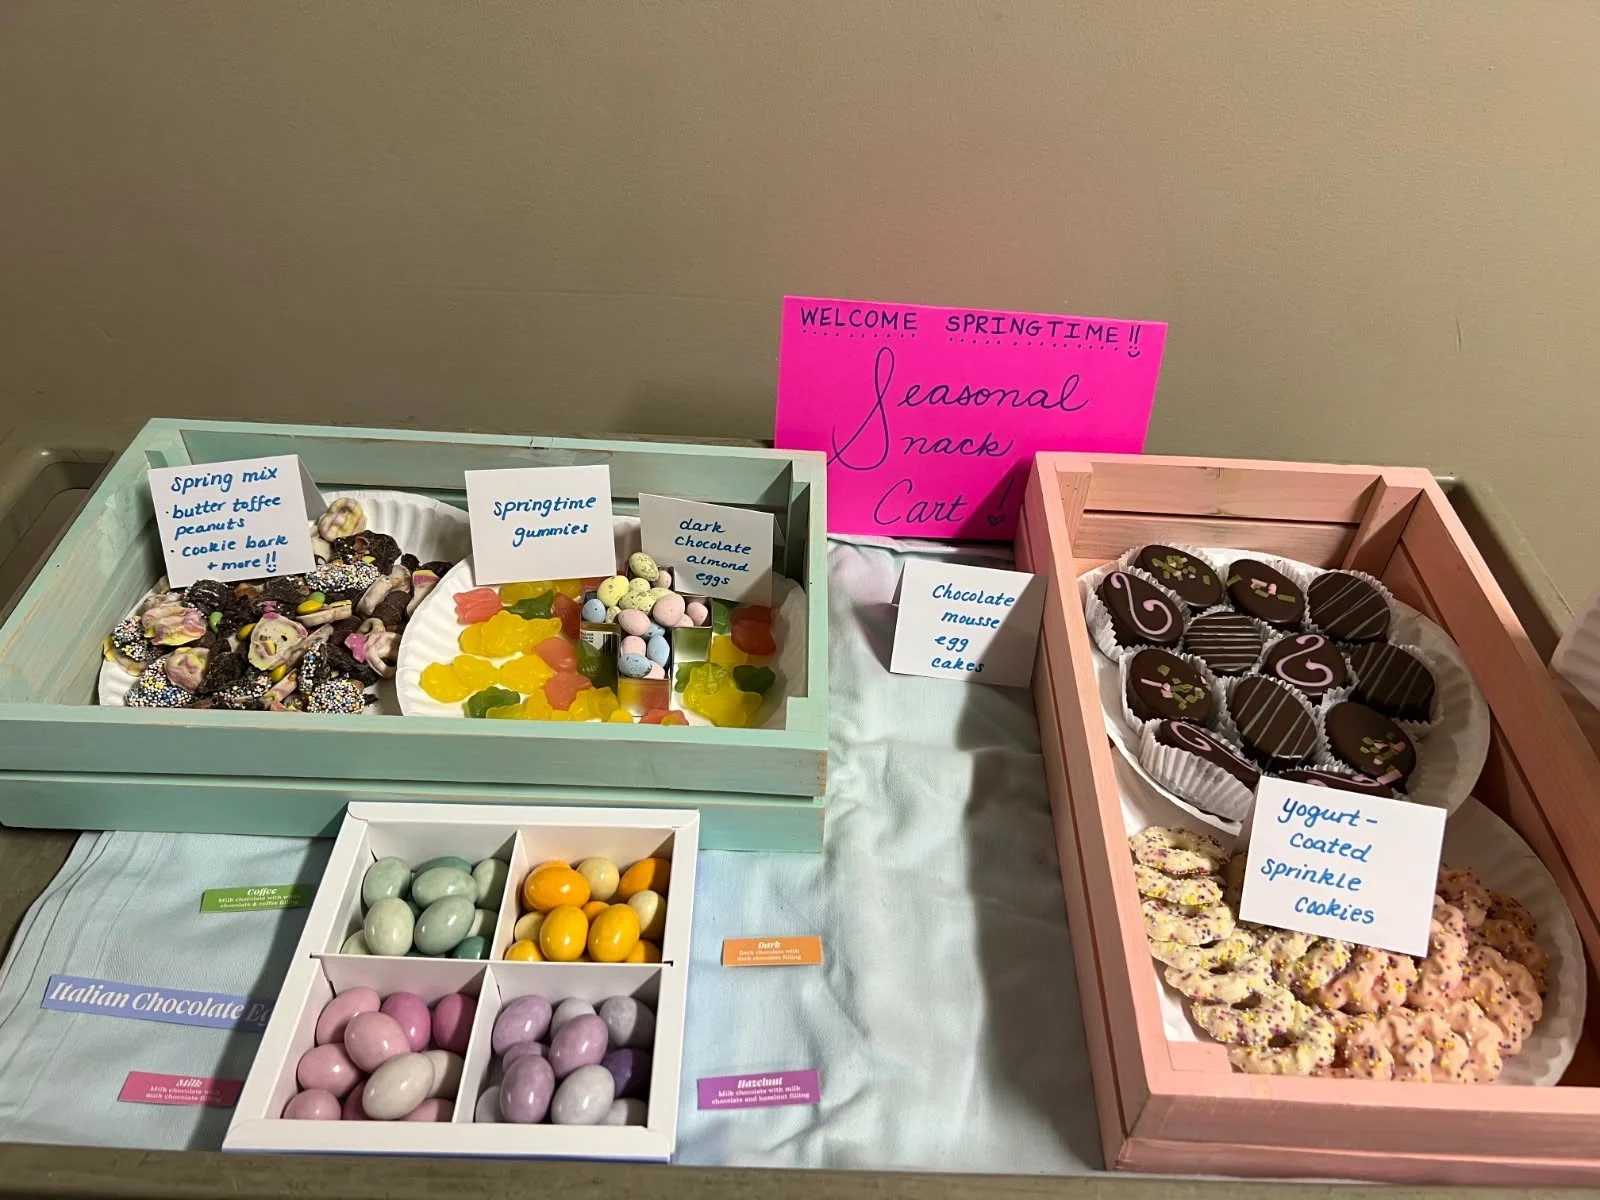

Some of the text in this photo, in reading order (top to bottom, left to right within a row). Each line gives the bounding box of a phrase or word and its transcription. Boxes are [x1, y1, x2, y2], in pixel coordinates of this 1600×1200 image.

[800, 306, 918, 331] WELCOME
[242, 467, 278, 483] mix
[172, 495, 281, 519] butter toffee
[174, 518, 245, 541] peanuts
[679, 517, 727, 533] dark
[245, 535, 288, 549] bark
[512, 523, 589, 547] gummies
[686, 554, 750, 572] almond
[695, 572, 731, 587] eggs
[941, 611, 1001, 629] mousse
[934, 634, 969, 652] egg
[247, 888, 278, 896] Coffee
[758, 941, 781, 949] Dark
[48, 982, 130, 1008] Italian
[132, 991, 246, 1020] Chocolate
[176, 1078, 203, 1088] Milk
[737, 1077, 784, 1089] Hazelnut
